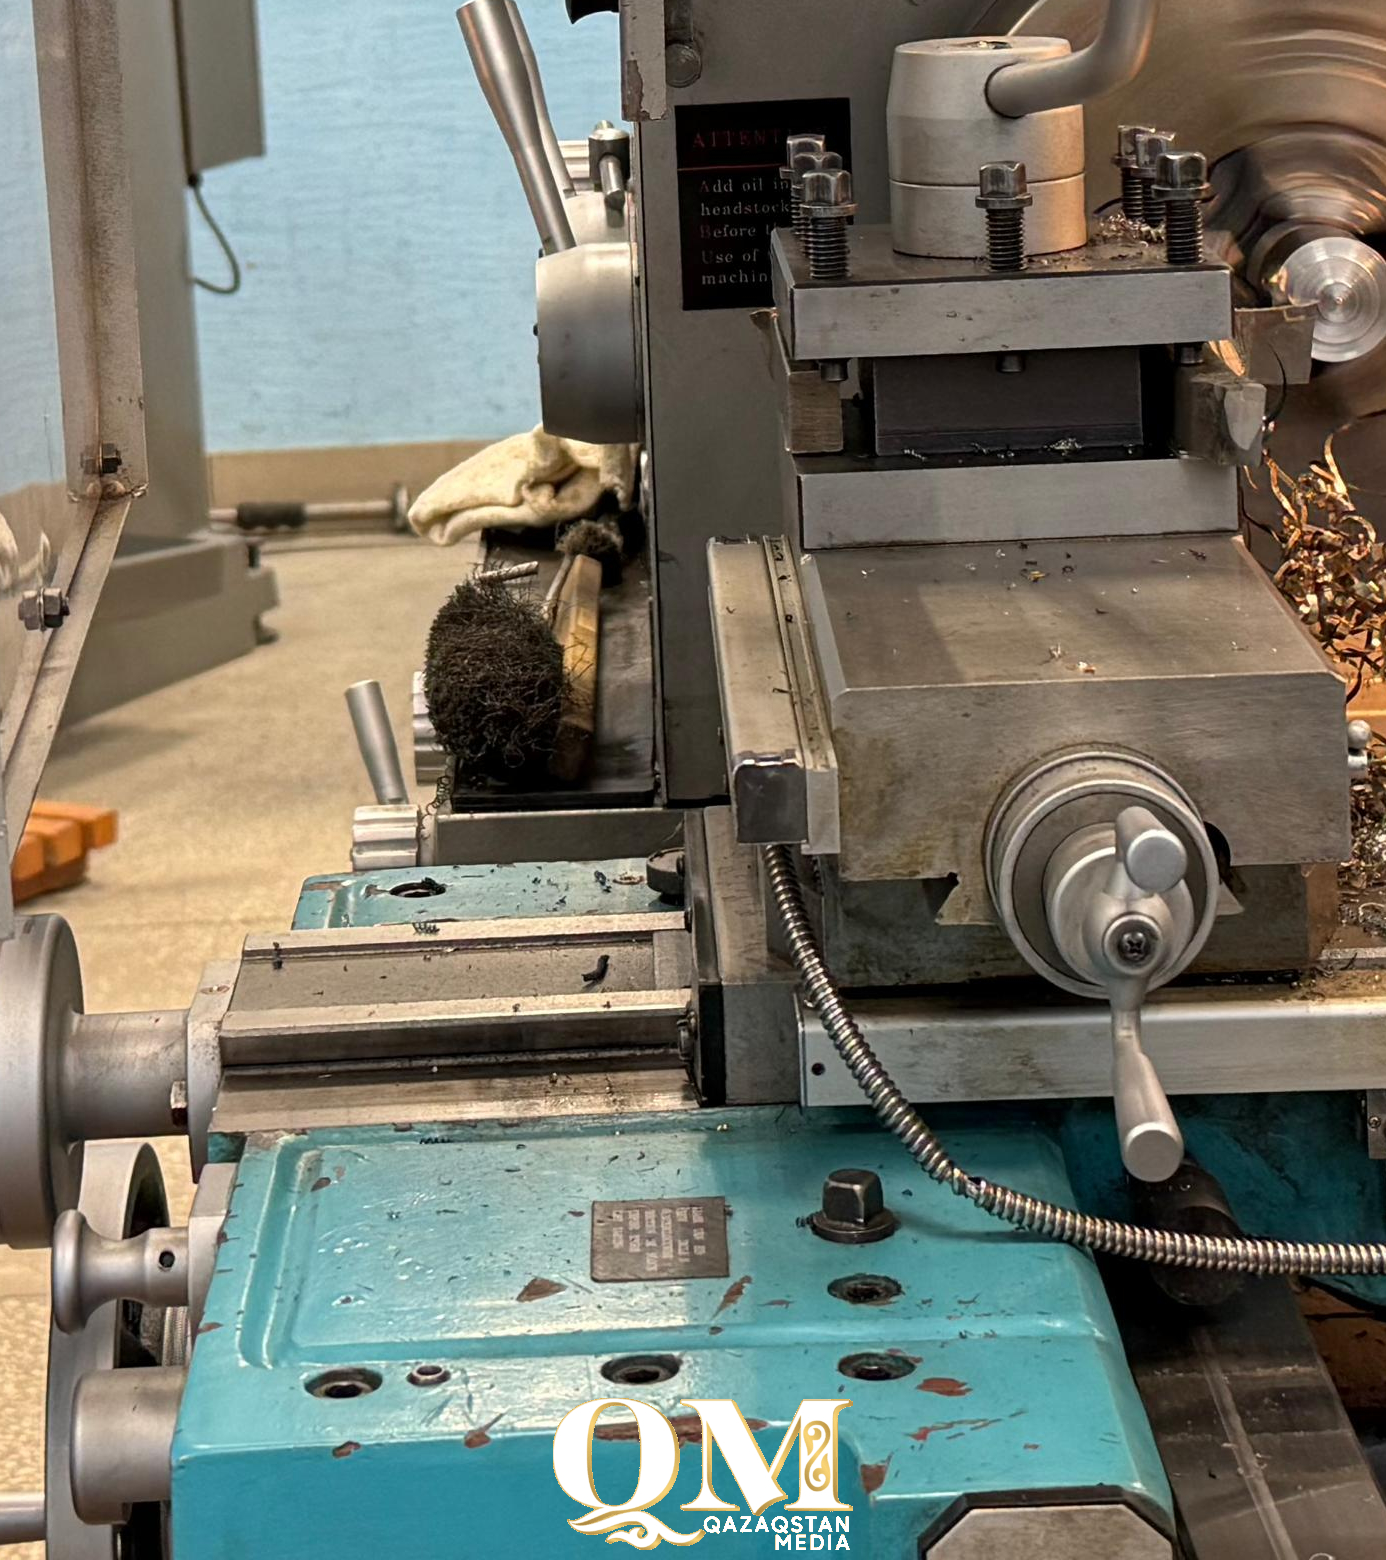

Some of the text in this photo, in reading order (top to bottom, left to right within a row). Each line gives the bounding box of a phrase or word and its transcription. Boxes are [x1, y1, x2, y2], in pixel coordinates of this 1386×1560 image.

[692, 127, 793, 149] ATTENT
[700, 178, 734, 193] Add
[742, 176, 764, 193] oil
[700, 223, 757, 239] Before
[701, 250, 734, 265] Use
[742, 248, 760, 263] of
[701, 269, 769, 286] machin
